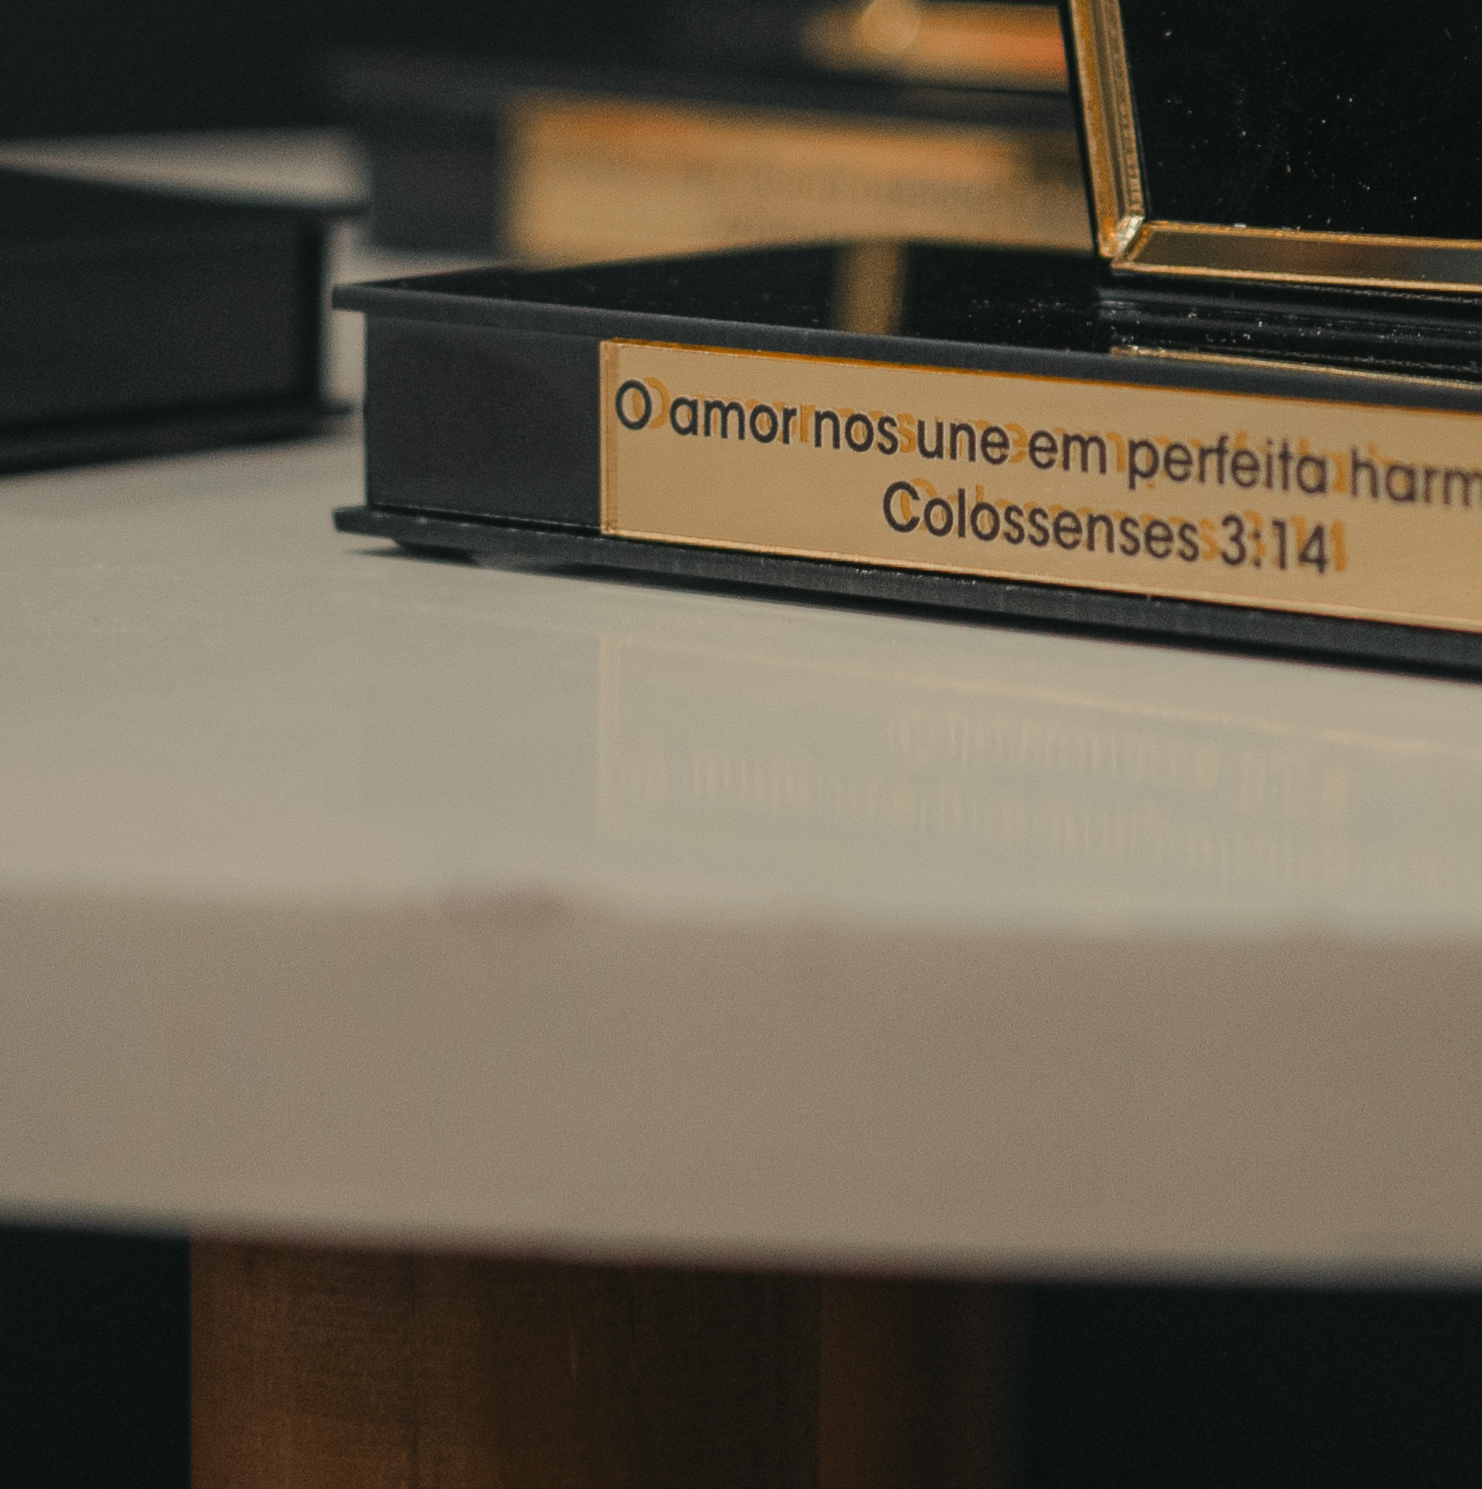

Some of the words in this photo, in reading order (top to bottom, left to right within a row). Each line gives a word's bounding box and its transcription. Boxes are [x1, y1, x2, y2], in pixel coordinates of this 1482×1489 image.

[615, 378, 653, 431] O
[669, 395, 798, 445] amor
[814, 408, 899, 456] nos
[918, 420, 1011, 465] une
[1028, 429, 1107, 475] em
[1127, 434, 1328, 495] perfeita
[882, 480, 1200, 562] Colossenses
[1219, 514, 1328, 575] 3:14
